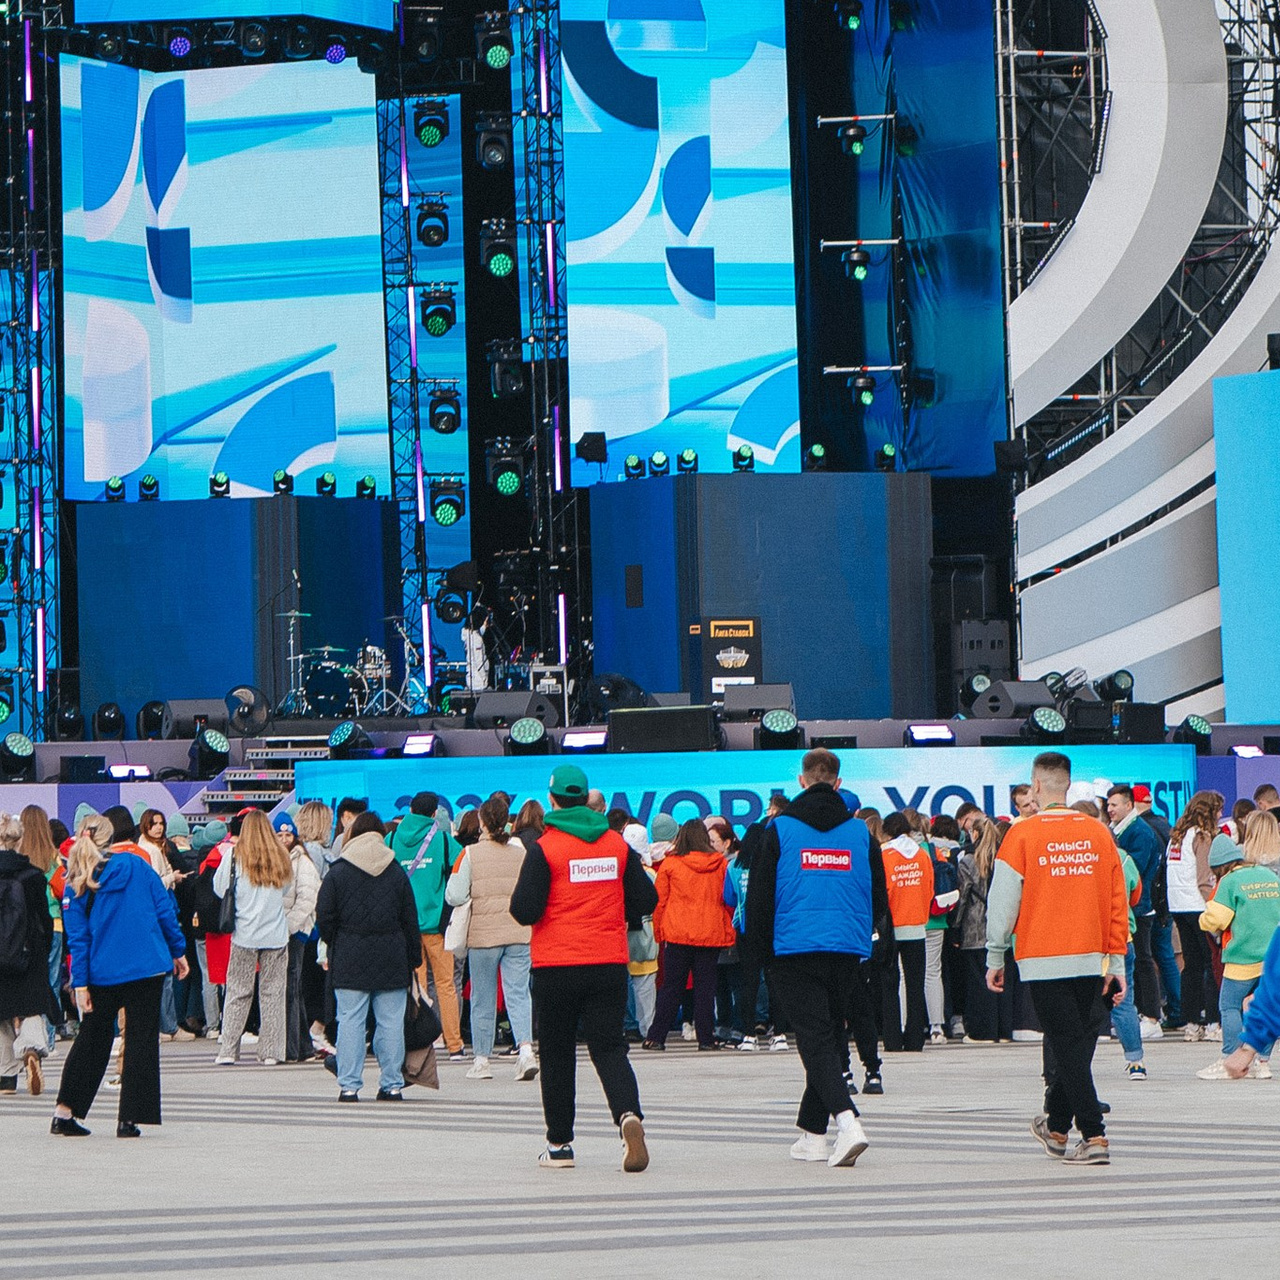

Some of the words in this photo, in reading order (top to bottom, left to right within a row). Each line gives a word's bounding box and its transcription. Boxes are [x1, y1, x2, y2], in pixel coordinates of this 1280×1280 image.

[1047, 840, 1091, 852] СМЫСЛ
[802, 852, 849, 867] Первые
[1038, 856, 1048, 866] В
[572, 864, 616, 877] Первые
[1051, 867, 1066, 877] ИЗ
[1068, 865, 1093, 875] НАС
